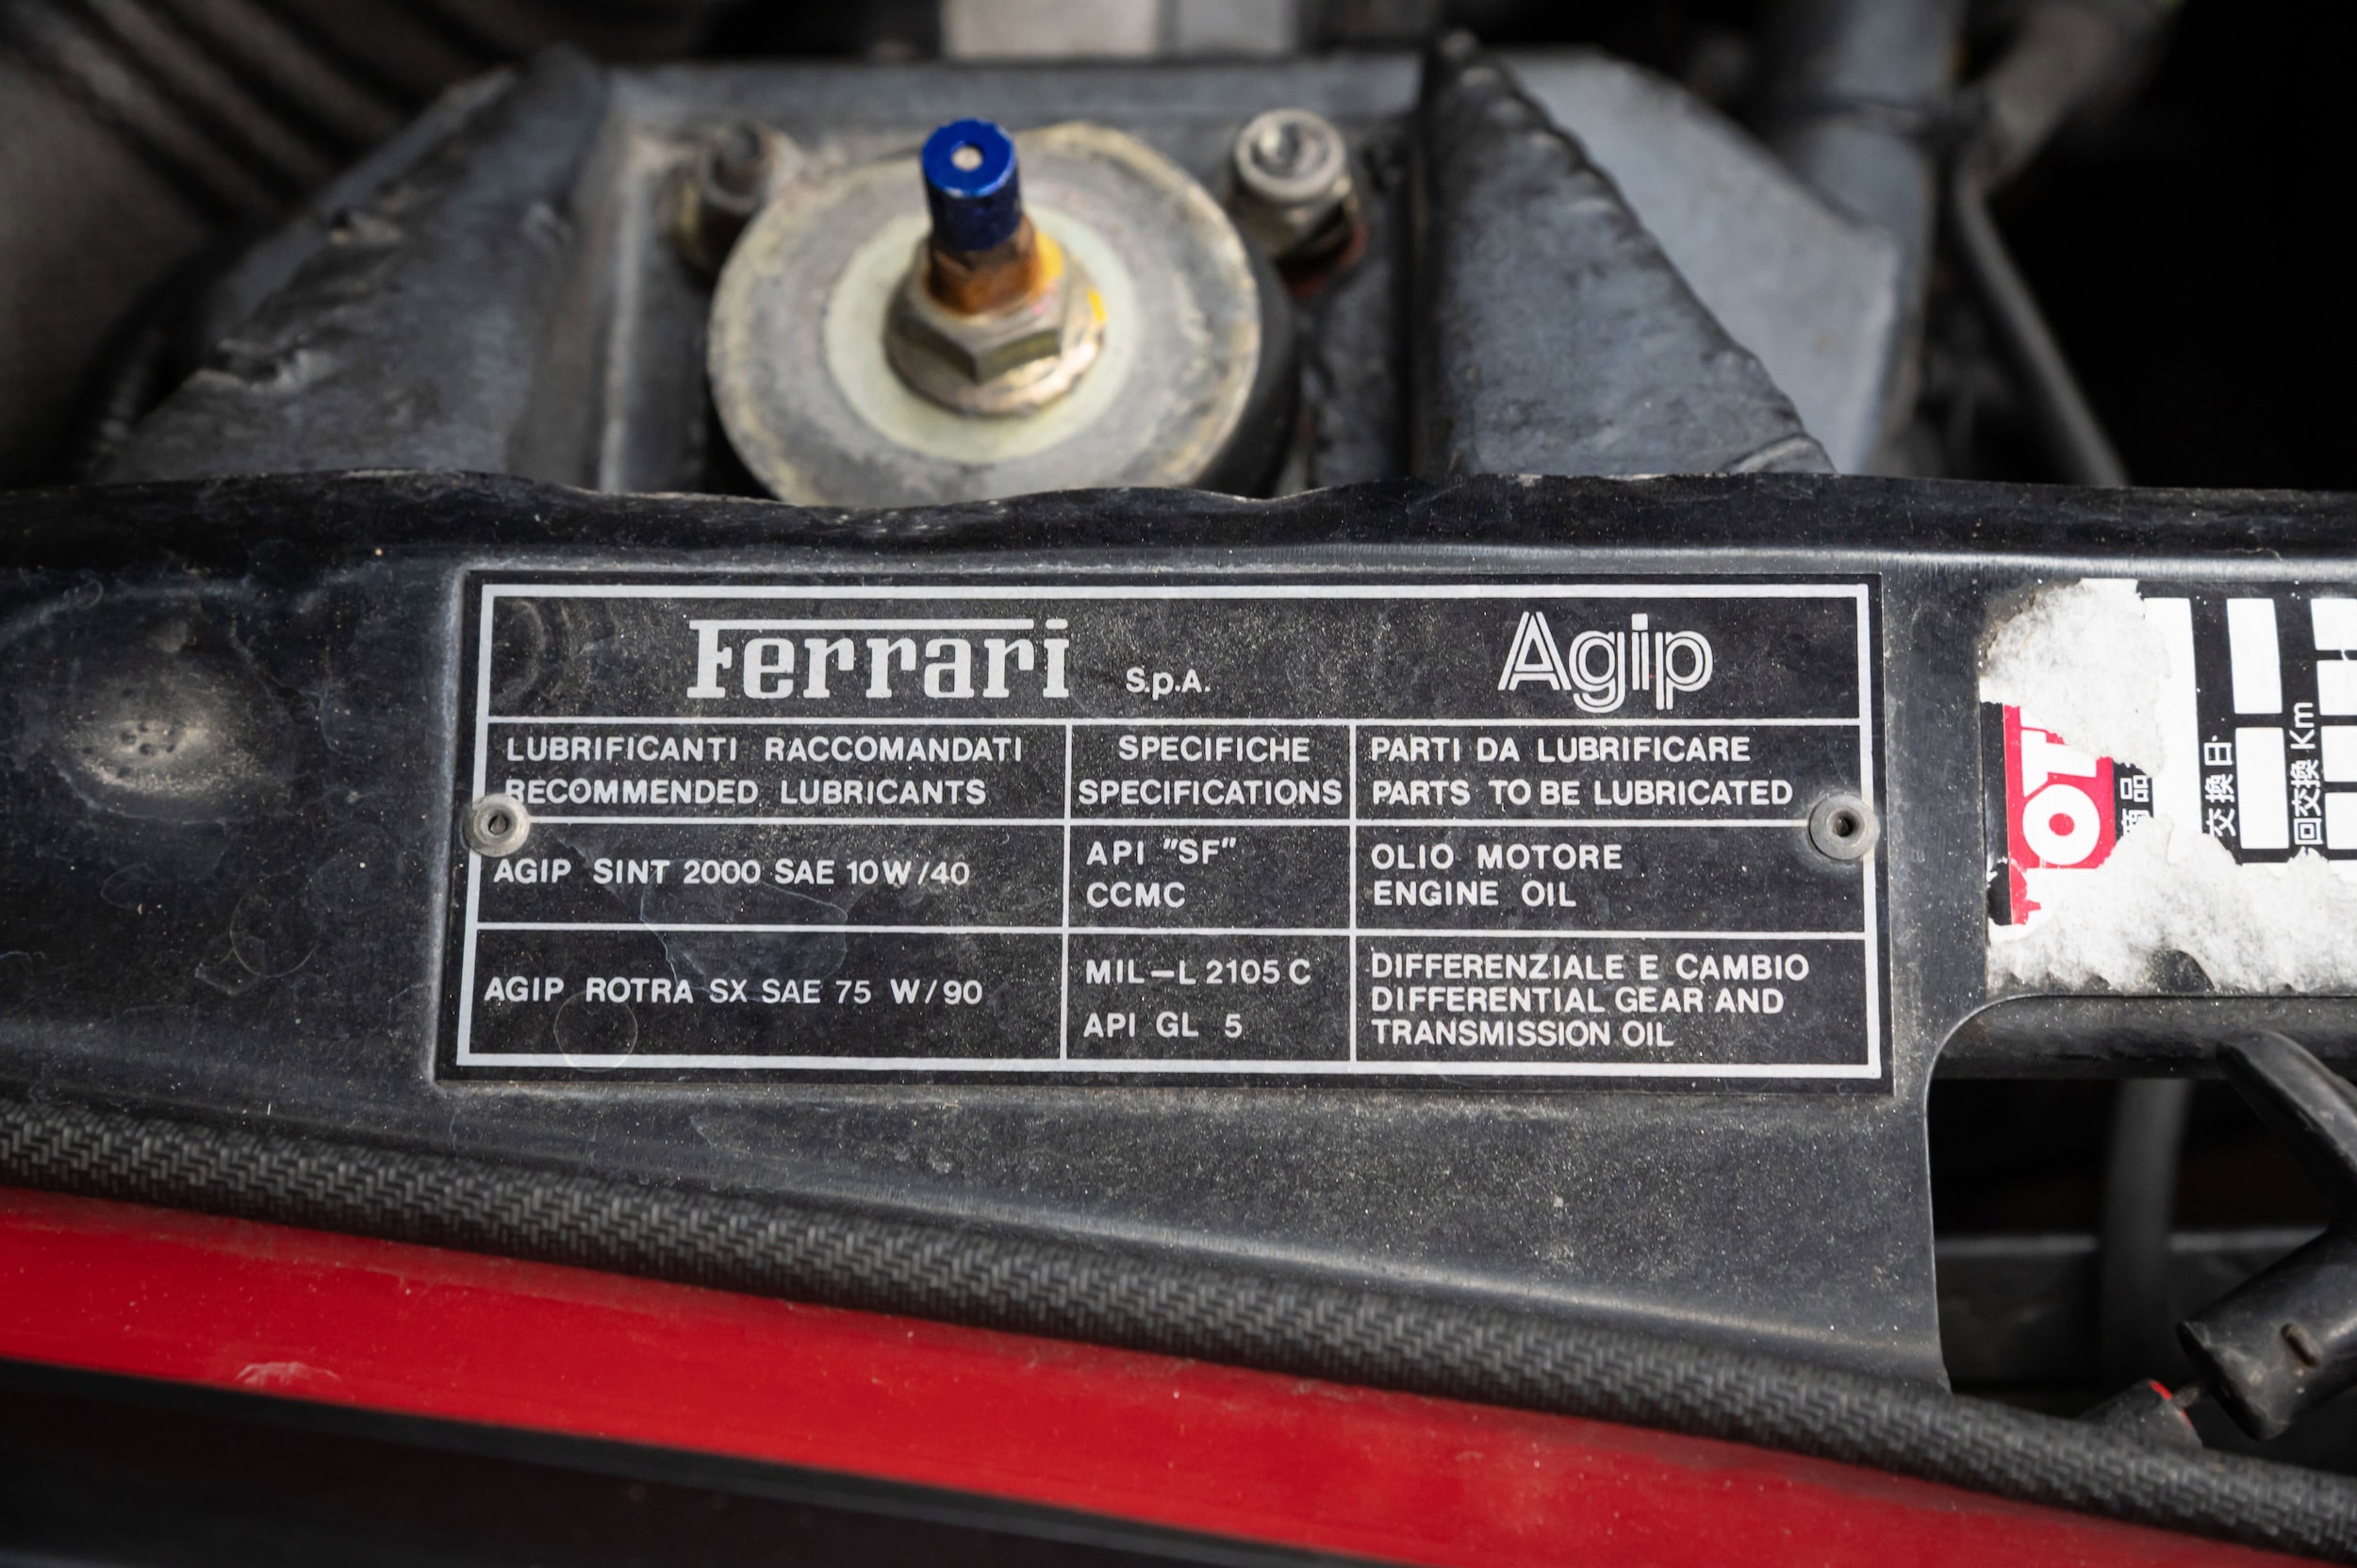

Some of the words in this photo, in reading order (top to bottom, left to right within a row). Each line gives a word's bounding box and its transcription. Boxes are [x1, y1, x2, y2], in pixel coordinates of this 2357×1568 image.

[686, 616, 1070, 700] Ferrari
[1126, 667, 1211, 701] S.p.A.
[1497, 611, 1713, 714] Agip
[2289, 701, 2316, 750] Km
[507, 734, 737, 762] LUBRIFICANTI
[765, 735, 1022, 763] RACCOMANDATI
[1118, 734, 1310, 763] SPECIFICHE
[1371, 734, 1460, 763] PARTI
[1476, 736, 1521, 763] DA
[1537, 735, 1751, 764] LUBRIFICARE
[504, 778, 759, 805] RECOMMENDED
[781, 778, 986, 805] LUBRICANTS
[1078, 778, 1343, 806] SPECIFICATIONS
[1372, 779, 1471, 807] PARTS
[1488, 778, 1532, 806] TO
[1540, 780, 1581, 806] BE
[1593, 779, 1793, 806] LUBRICATED
[2203, 741, 2236, 837] 交換日
[1086, 839, 1145, 866] API
[1371, 843, 1455, 870] OLIO
[1477, 843, 1623, 870] MOTORE
[493, 858, 571, 884] AGIP
[593, 858, 671, 884] SINT
[683, 859, 761, 884] 2000
[774, 858, 835, 884] SAE
[1086, 881, 1186, 909] CCMC
[1374, 880, 1499, 907] ENGINE
[1521, 880, 1577, 908] OIL
[1206, 959, 1280, 984] 2105
[1289, 958, 1311, 985] C
[1371, 951, 1625, 981] DIFFERENZIALE
[1639, 953, 1659, 981] E
[1674, 952, 1809, 984] CAMBIO
[484, 976, 565, 1002] AGIP
[585, 977, 694, 1004] ROTRA
[709, 978, 748, 1003] SX
[761, 978, 821, 1004] SAE
[835, 980, 871, 1004] 75
[1371, 985, 1606, 1014] DIFFERENTIAL
[1614, 985, 1704, 1014] GEAR
[1714, 987, 1785, 1015] AND
[1083, 1012, 1136, 1038] API
[1156, 1011, 1199, 1038] GL
[1224, 1013, 1243, 1038] 5
[1371, 1016, 1611, 1048] TRANSMISSION
[1622, 1019, 1675, 1048] OIL
